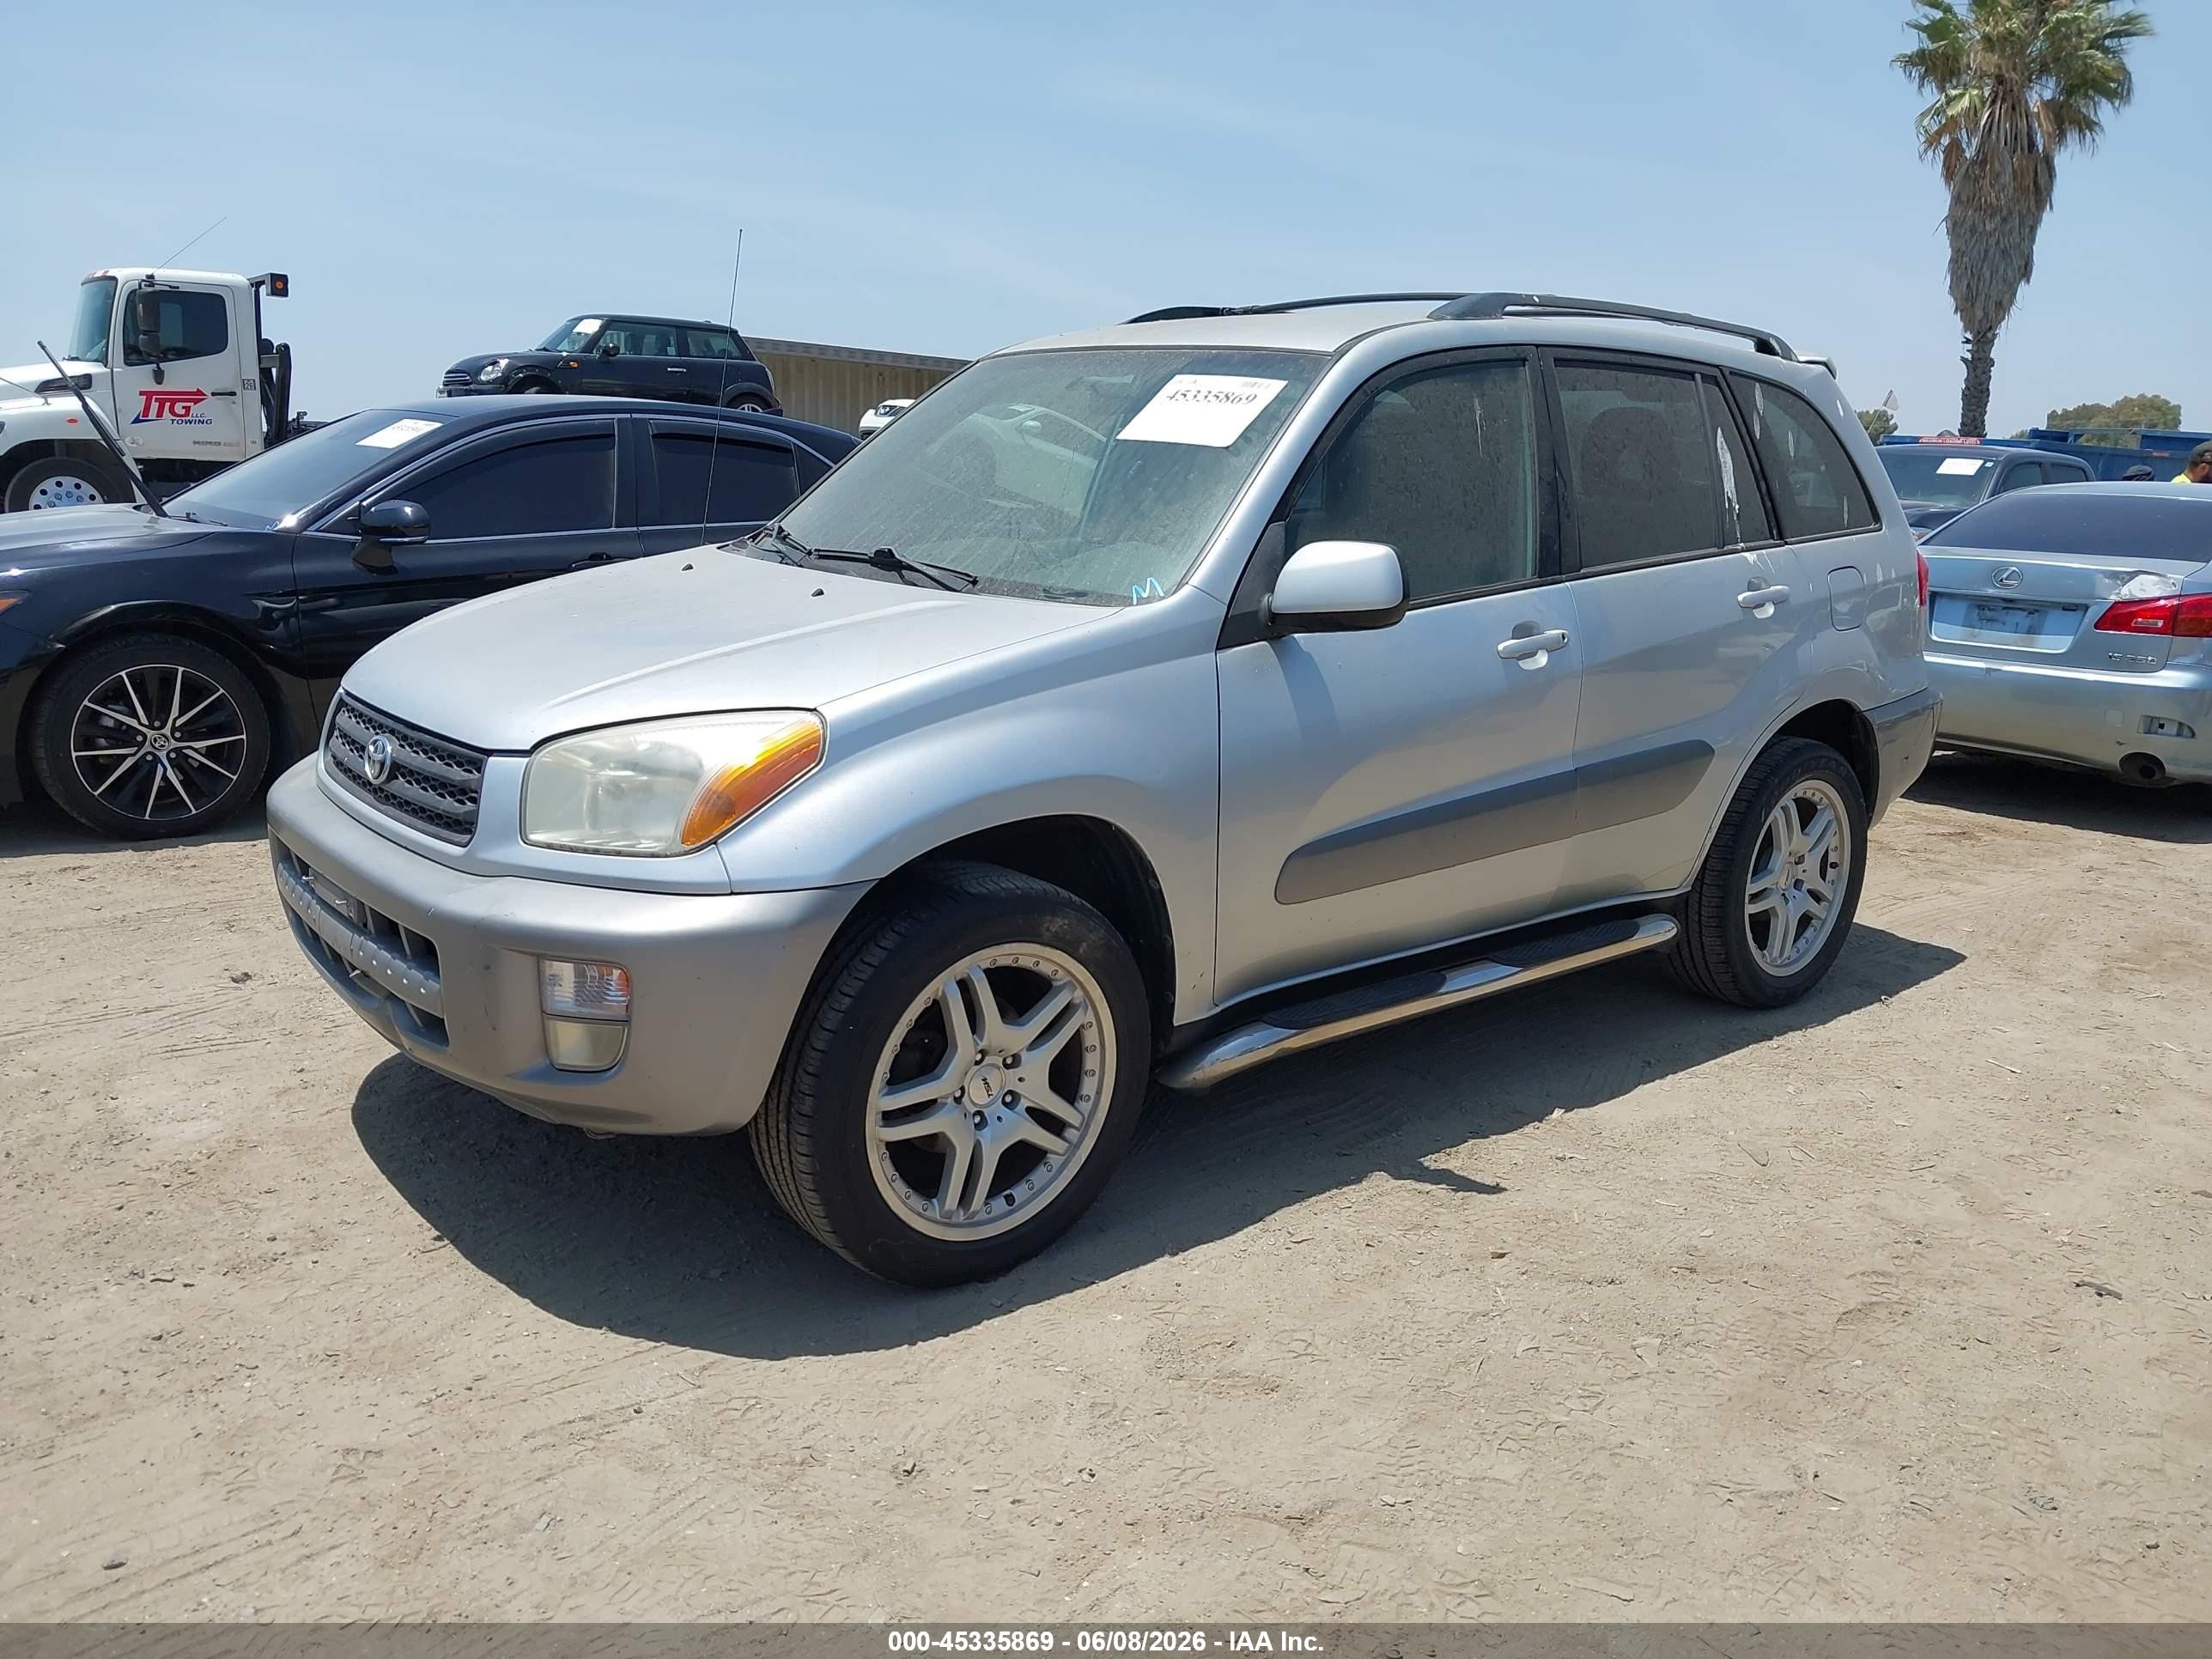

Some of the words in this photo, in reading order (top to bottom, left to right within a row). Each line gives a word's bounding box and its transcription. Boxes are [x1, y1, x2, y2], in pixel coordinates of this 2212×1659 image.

[139, 390, 199, 418] TTG
[1166, 390, 1258, 405] 45335869
[1133, 577, 1164, 605] M
[981, 1076, 994, 1099] TSW
